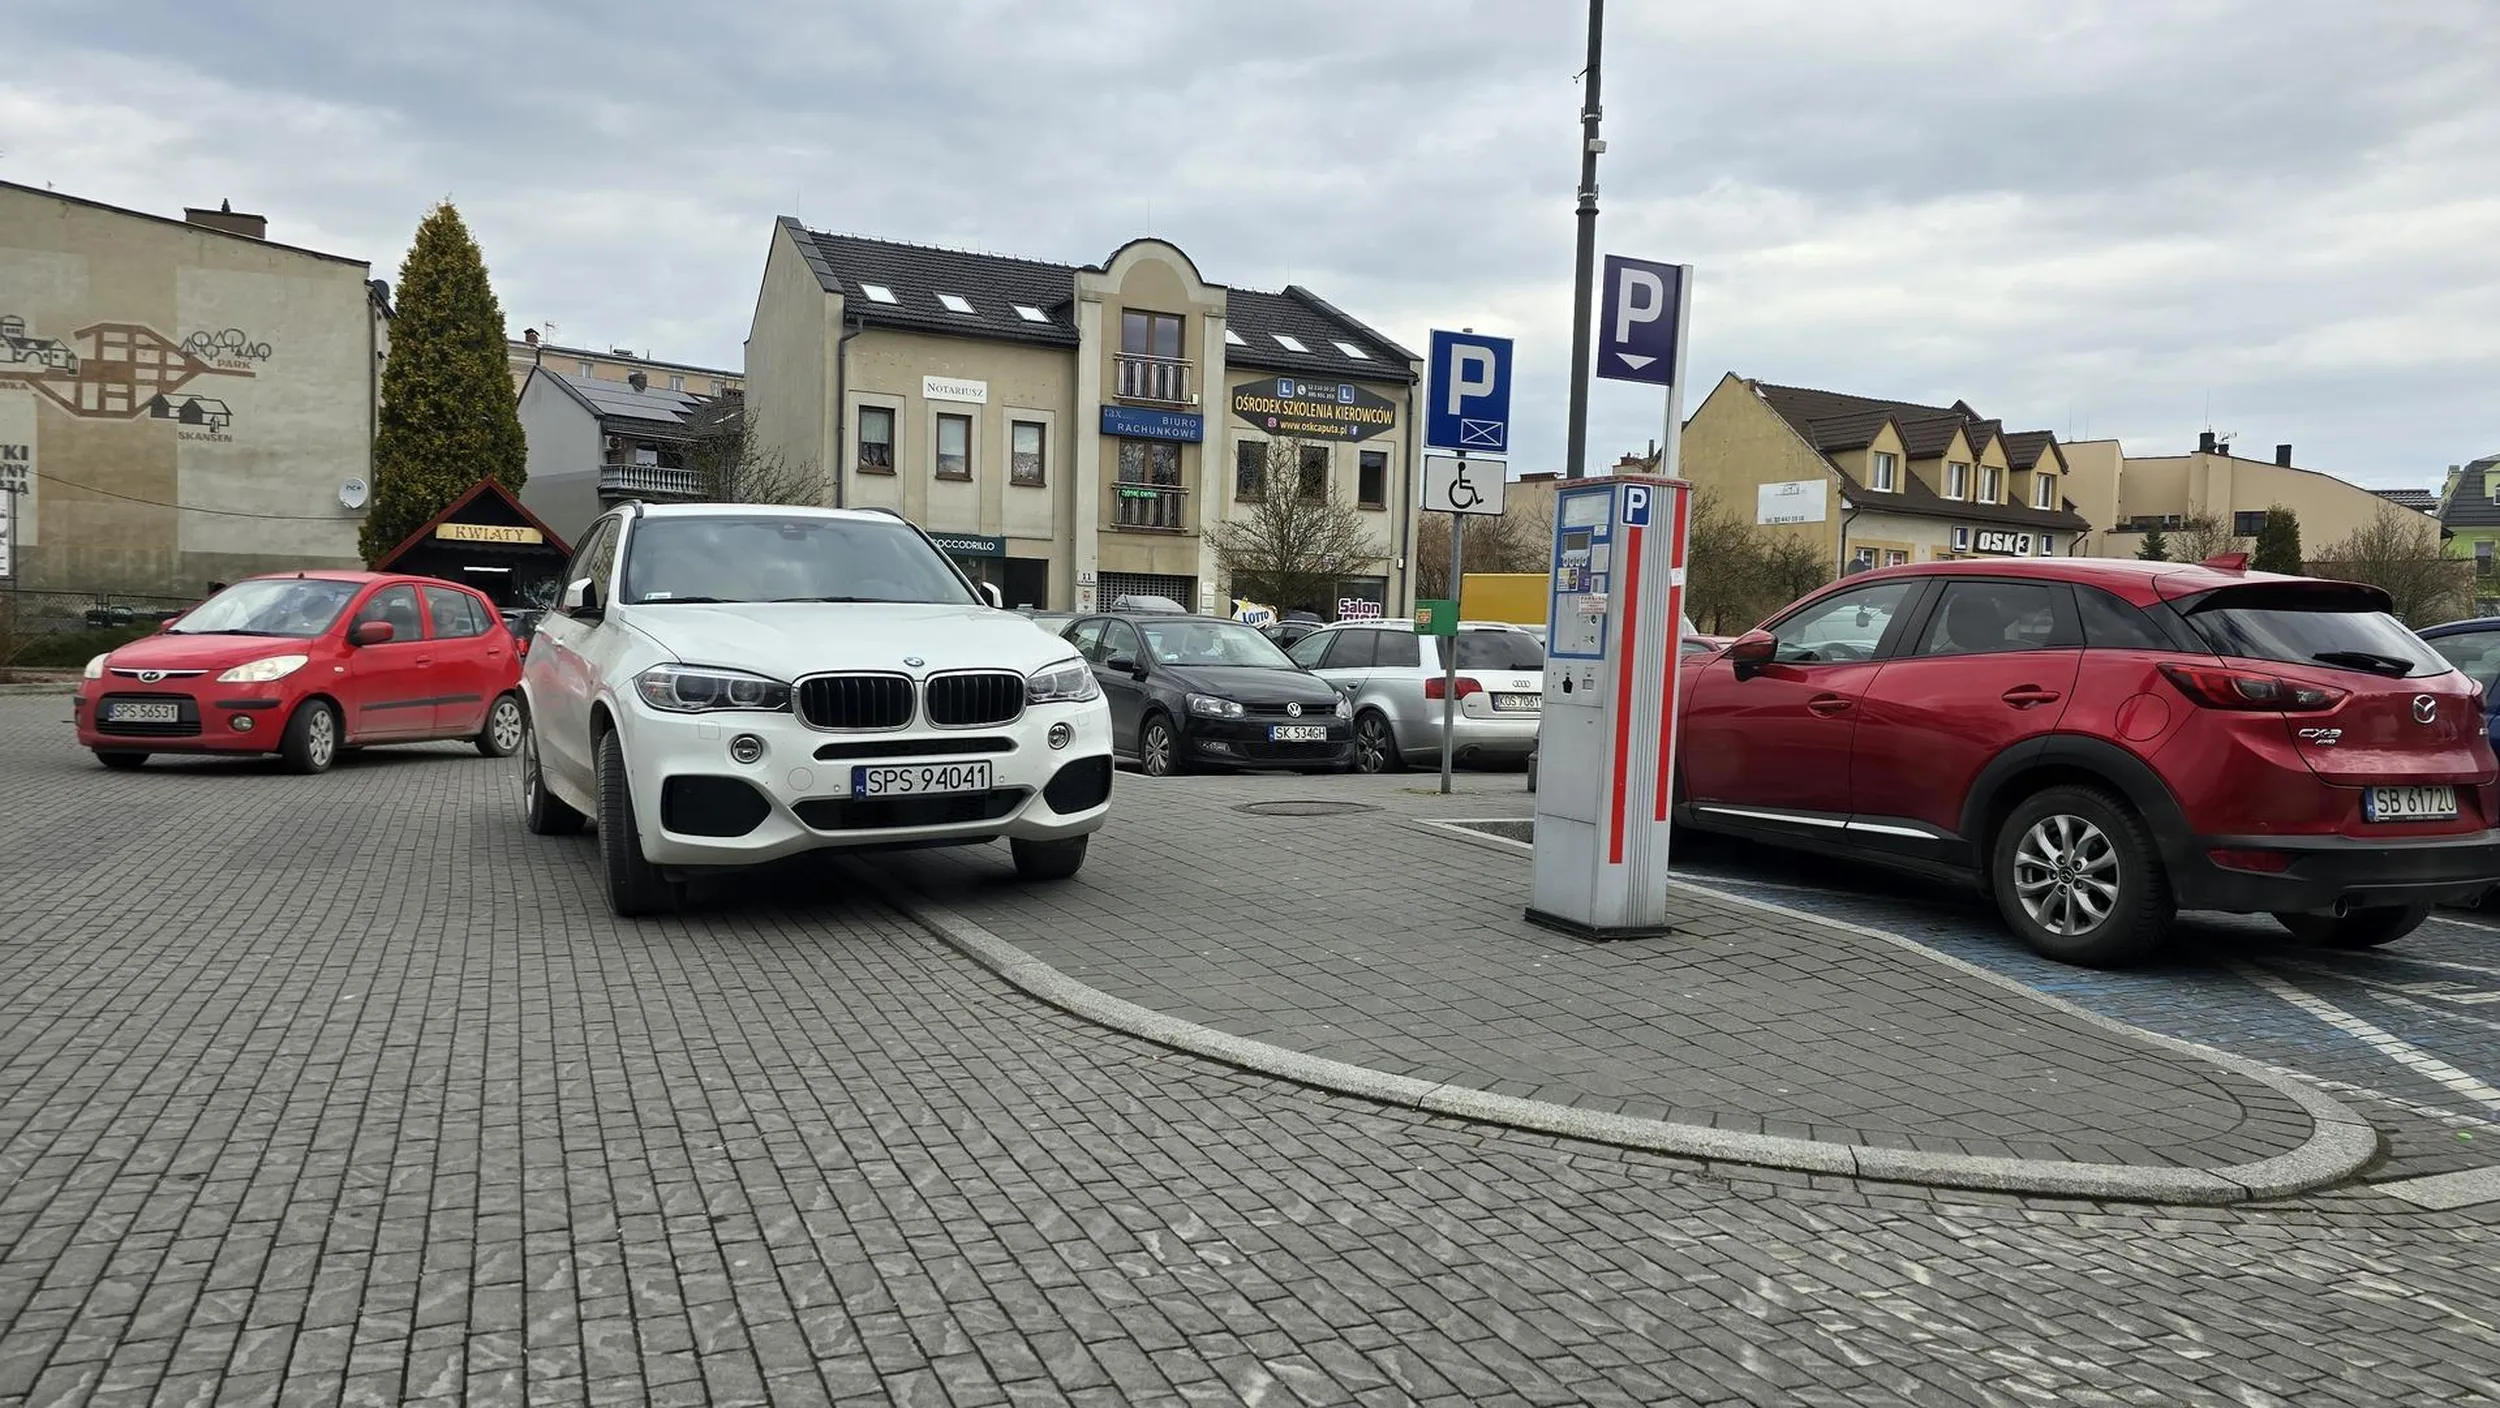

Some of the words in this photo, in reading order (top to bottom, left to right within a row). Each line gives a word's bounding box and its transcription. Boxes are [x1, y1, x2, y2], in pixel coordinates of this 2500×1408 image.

[1616, 267, 1664, 343] P
[217, 359, 253, 369] PARK
[1448, 343, 1496, 415] P
[927, 382, 984, 397] NOTARIUSZ
[1235, 393, 1282, 412] OŚRODEK
[1282, 401, 1333, 419] SZKOLENIA
[1335, 405, 1394, 425] KIEROWCÓW
[1162, 416, 1197, 428] BIURO
[178, 431, 233, 443] SKANSEN
[1117, 423, 1196, 439] RACHUNKOWE
[1626, 488, 1647, 522] P
[455, 526, 525, 542] KWIATY
[1978, 532, 2016, 552] OSK
[1339, 598, 1381, 615] Salon
[1242, 611, 1270, 625] LOTTO
[1518, 695, 1542, 707] 7061
[115, 704, 137, 718] SPS
[1275, 727, 1290, 739] SK
[868, 769, 913, 793] SPS
[921, 765, 985, 791] 94041
[2376, 788, 2402, 813] SB
